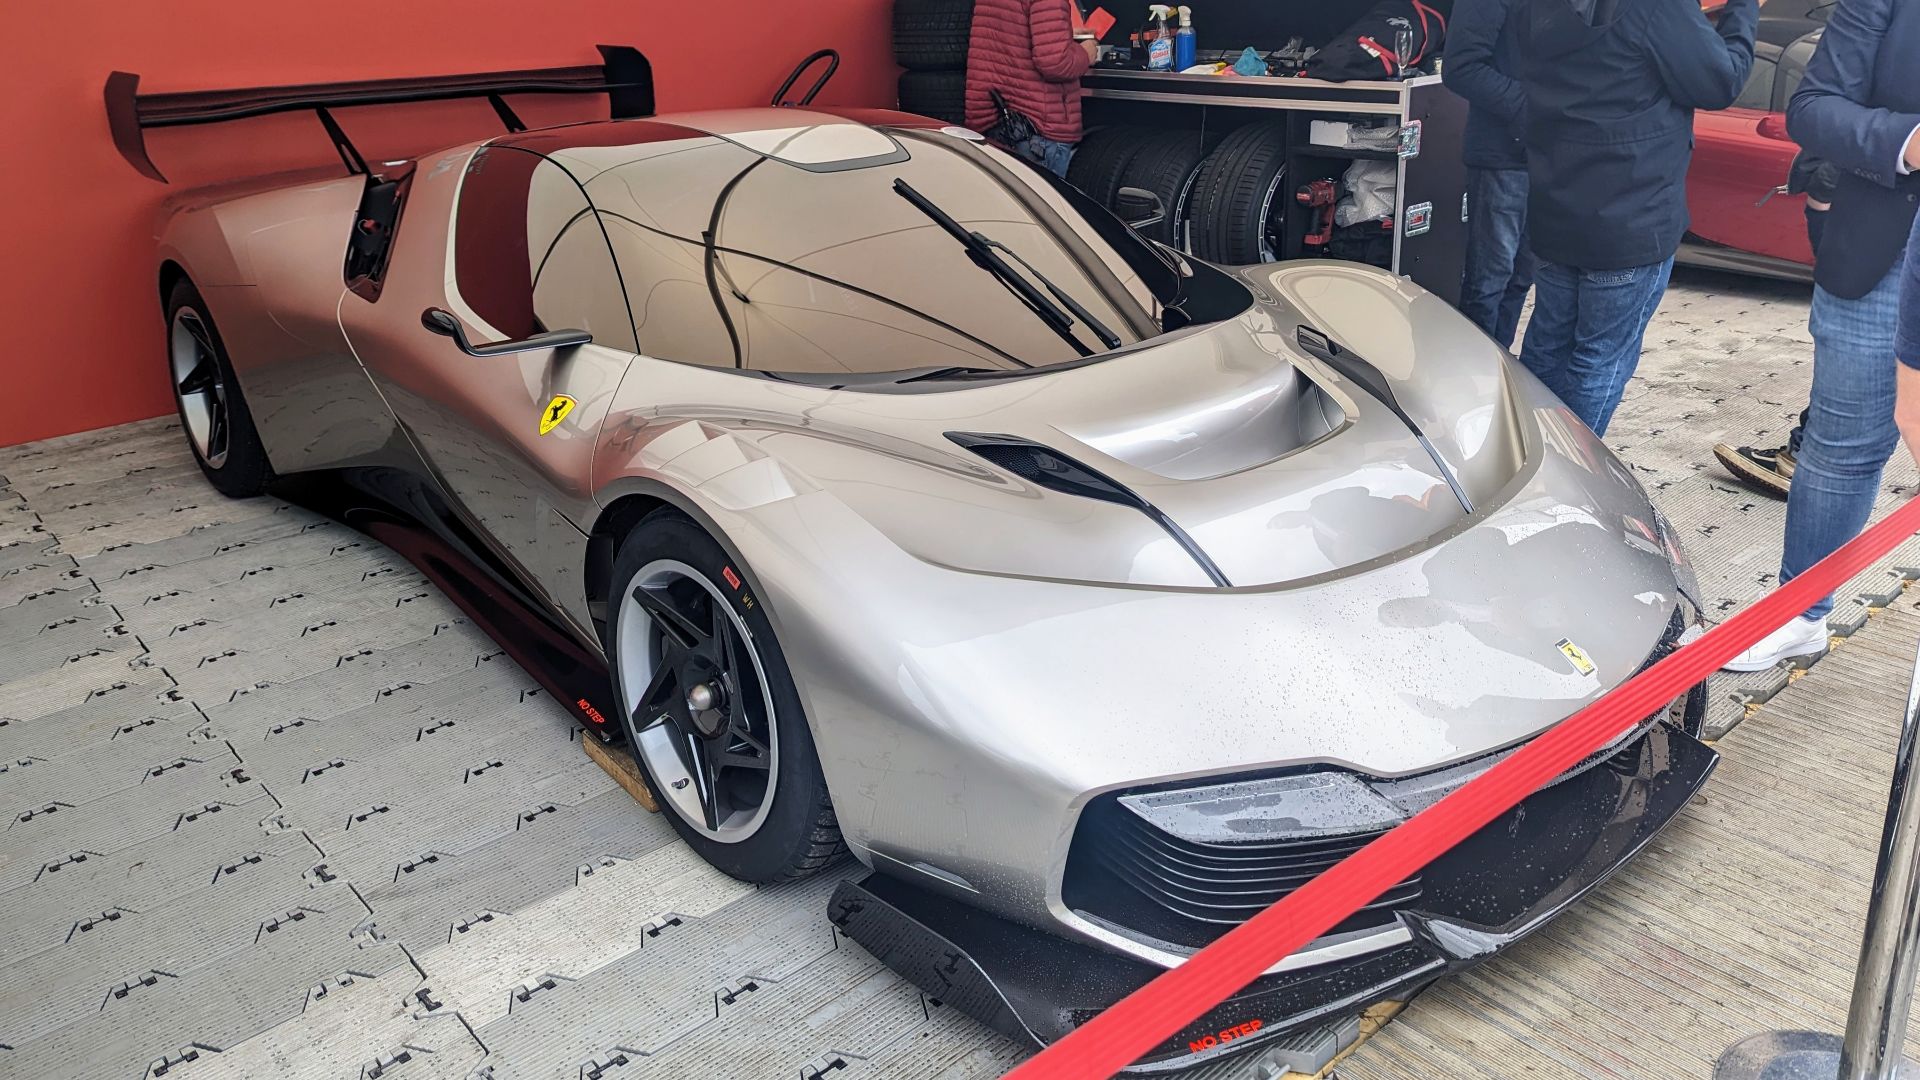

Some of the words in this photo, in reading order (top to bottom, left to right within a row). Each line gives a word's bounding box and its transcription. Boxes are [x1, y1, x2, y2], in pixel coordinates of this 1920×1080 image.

[577, 698, 590, 710] NO
[586, 707, 605, 724] STEP
[1188, 1035, 1217, 1053] NO
[1219, 1019, 1263, 1044] STEP
